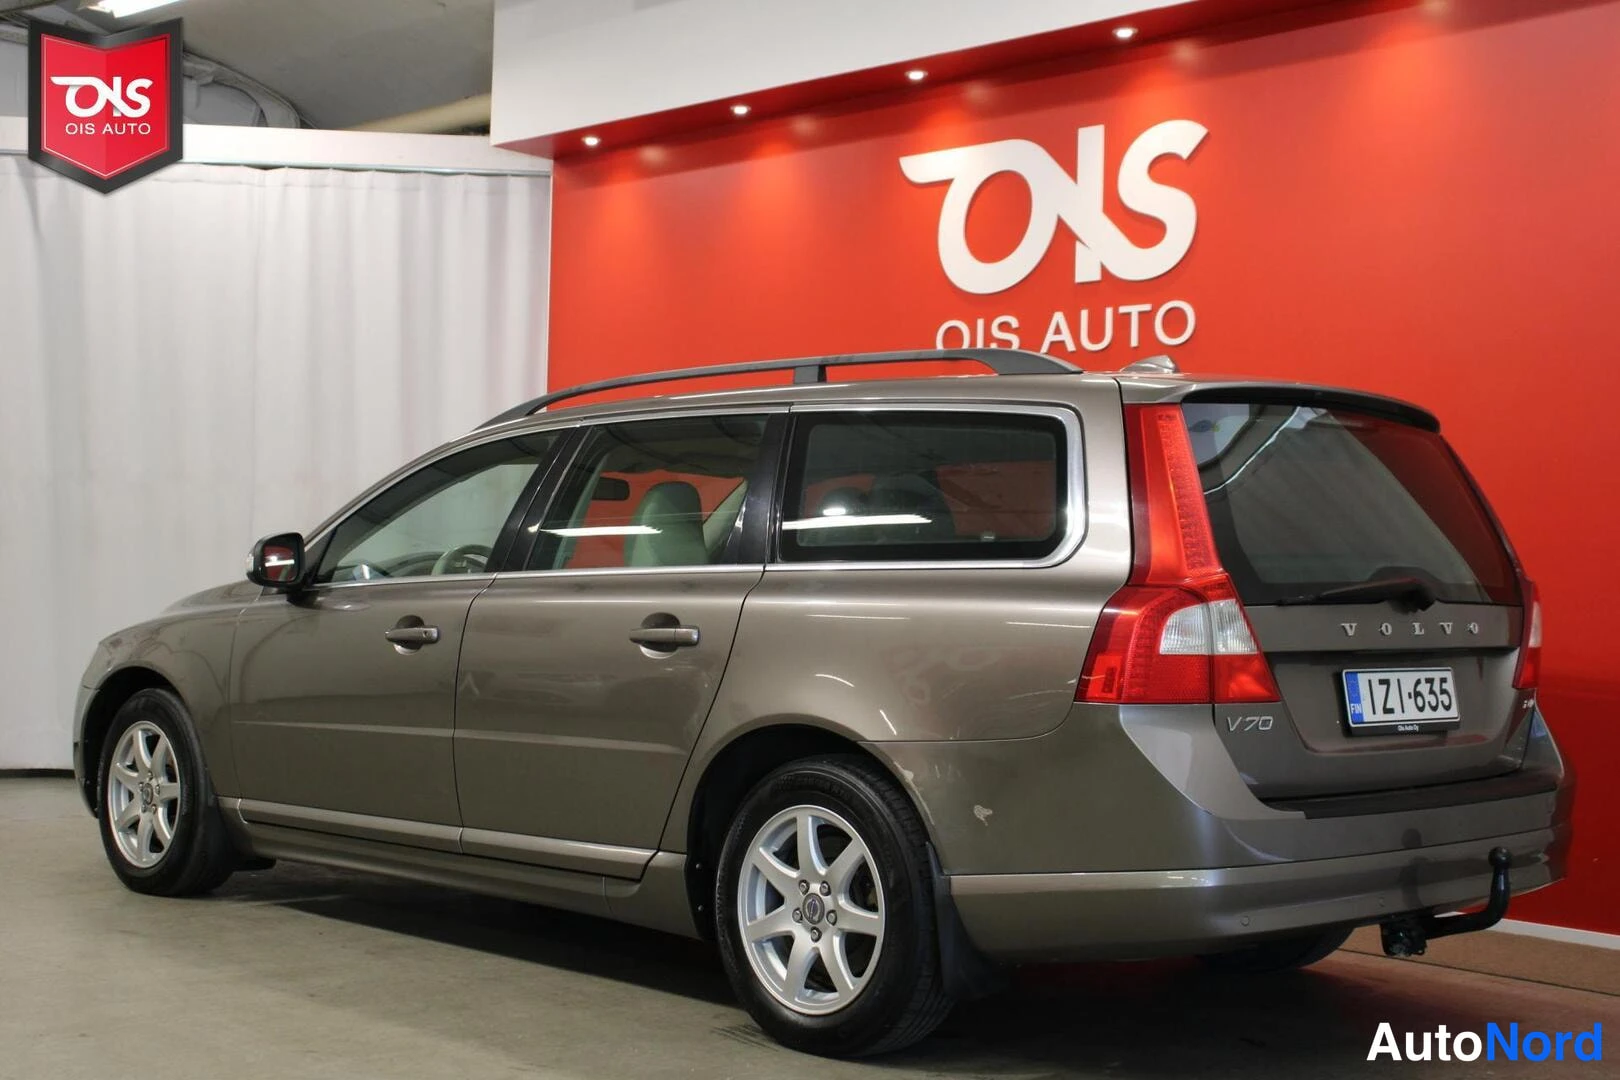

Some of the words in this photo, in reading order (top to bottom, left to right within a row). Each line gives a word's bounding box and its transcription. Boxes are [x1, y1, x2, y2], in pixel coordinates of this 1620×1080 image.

[935, 315, 1020, 350] OIS
[1040, 300, 1196, 353] AUTO
[1341, 621, 1480, 637] VOLVO
[1350, 703, 1363, 714] FIN
[1226, 715, 1273, 731] V70
